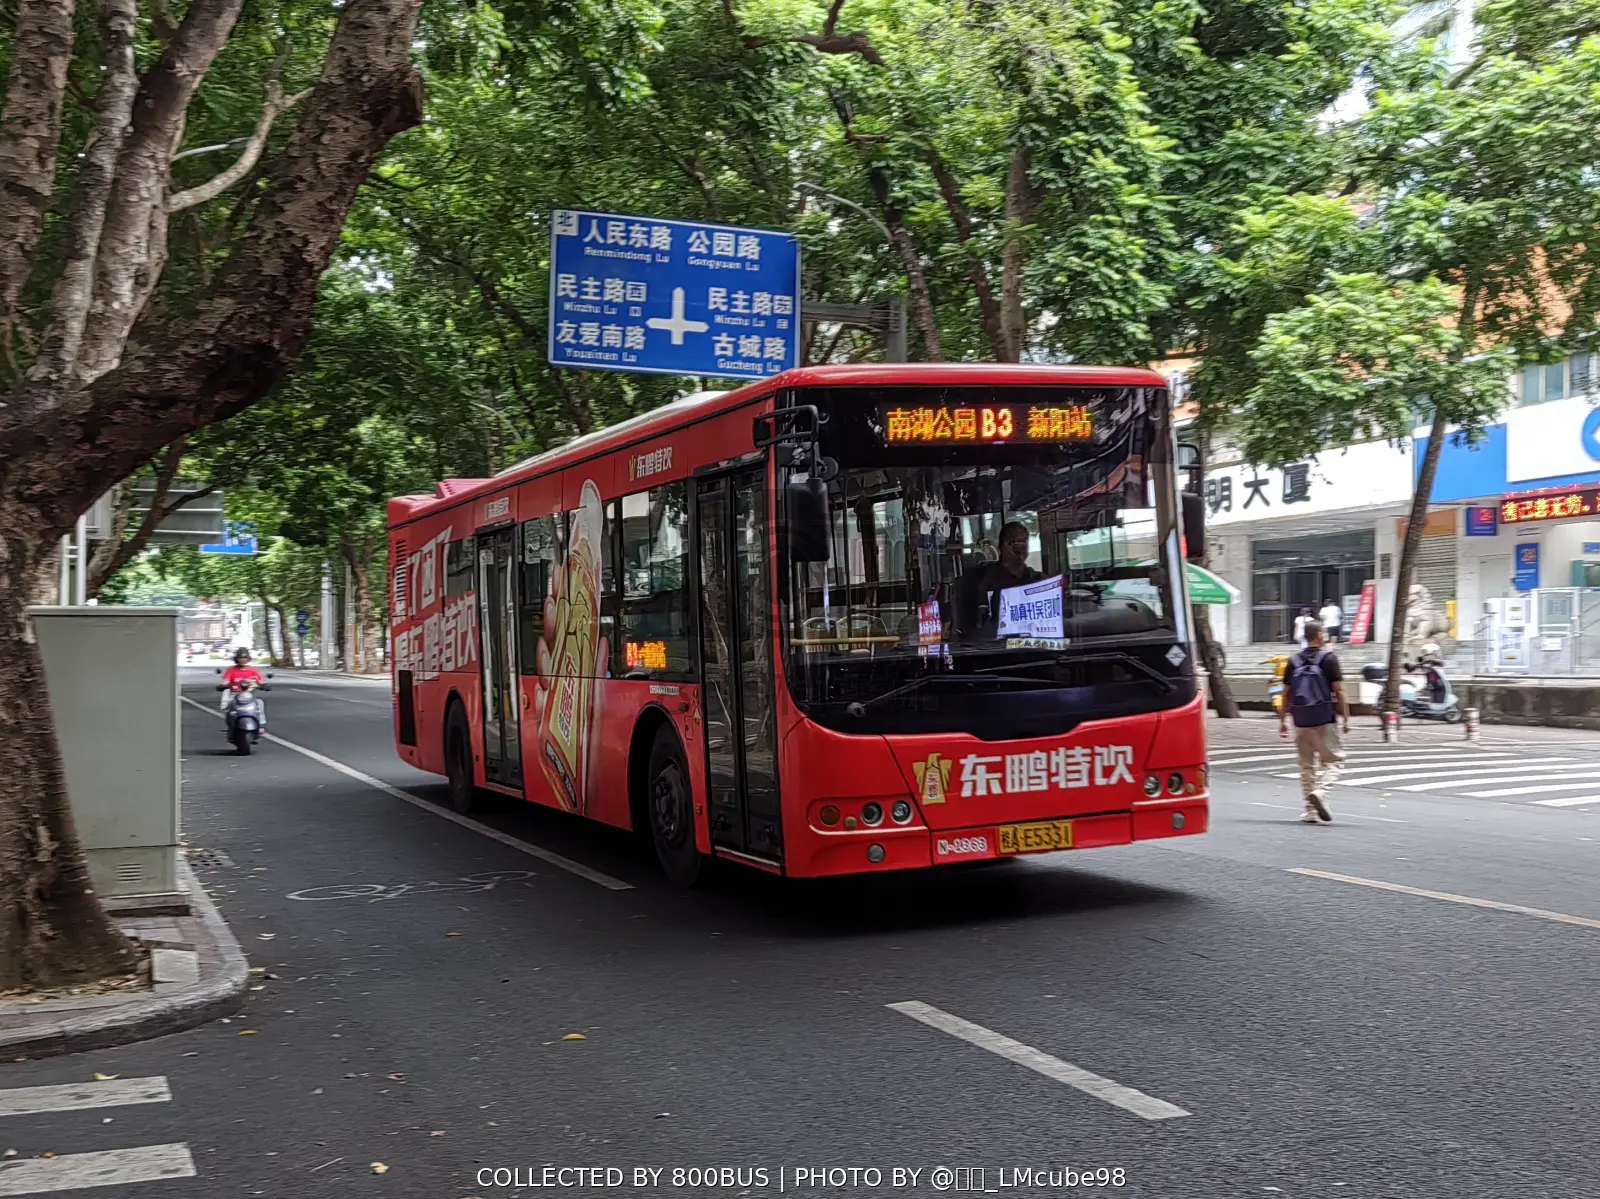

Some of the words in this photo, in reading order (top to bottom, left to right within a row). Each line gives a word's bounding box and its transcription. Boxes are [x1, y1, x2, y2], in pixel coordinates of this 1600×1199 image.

[583, 219, 672, 250] 人民东路
[687, 230, 761, 260] 公园路
[688, 256, 741, 271] Gongyuan
[556, 320, 646, 350] 友爱南路
[711, 332, 787, 360] 古城路
[717, 358, 763, 374] Gucheng
[887, 407, 976, 441] 南湖公园
[981, 408, 1013, 440] B3
[1027, 405, 1092, 439] 新阳站
[636, 447, 672, 478] 东鹏特饮
[1204, 463, 1311, 515] 明大厦
[959, 744, 1135, 798] 东鹏特饮
